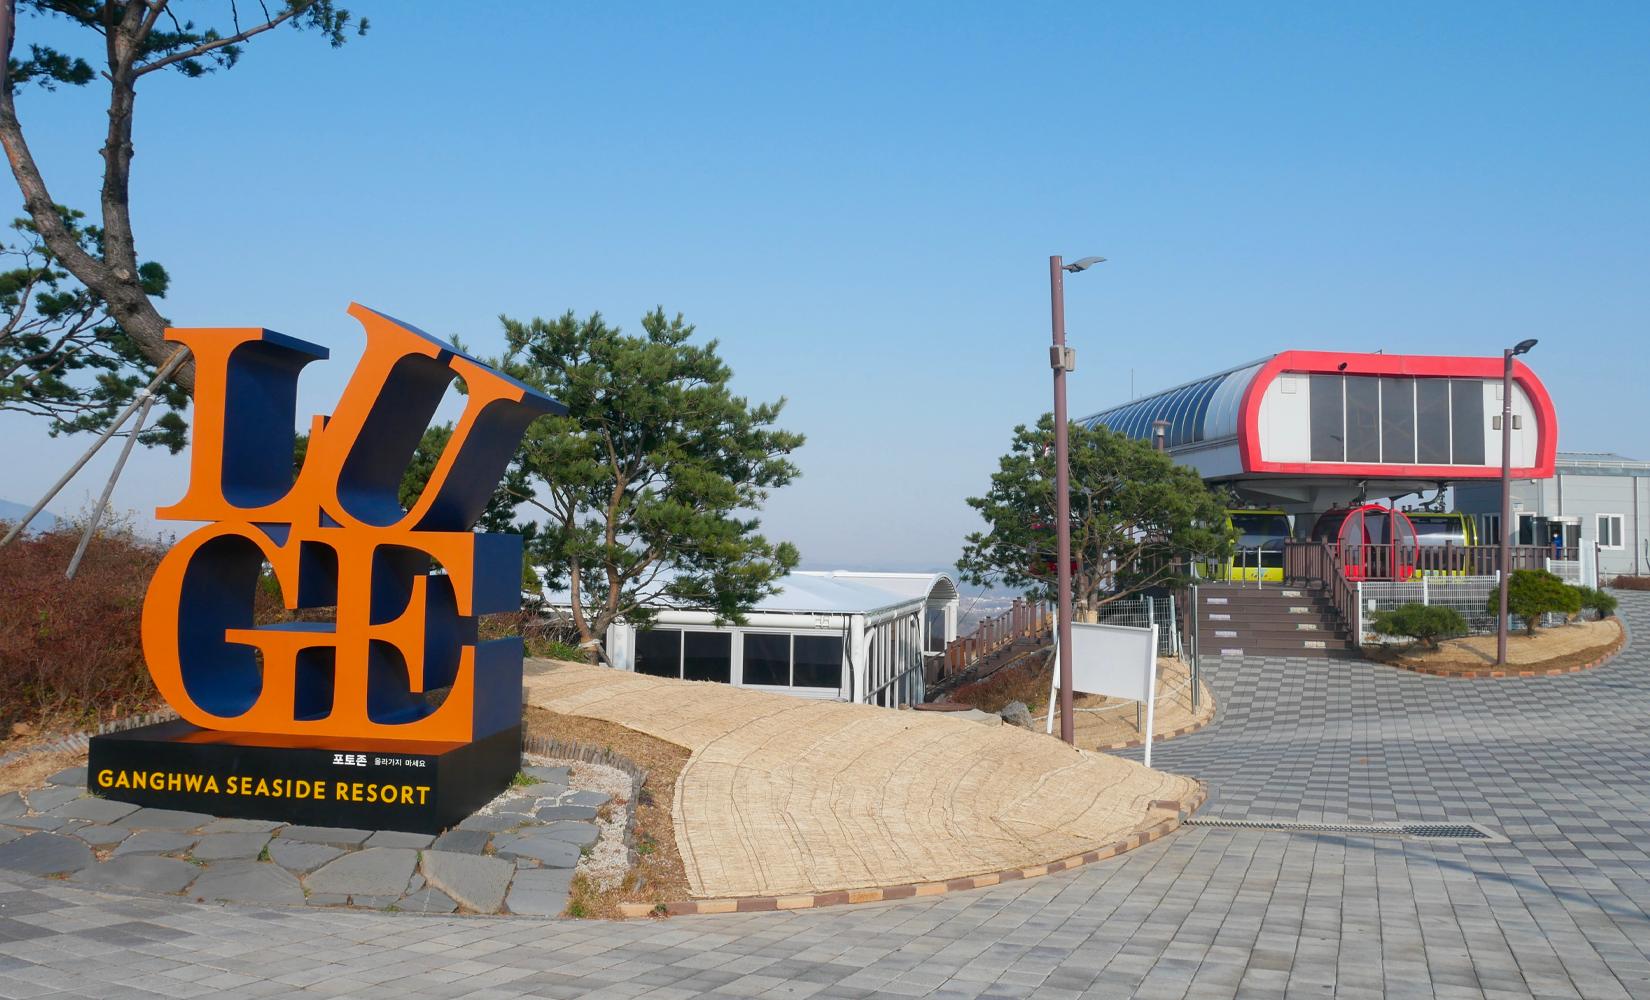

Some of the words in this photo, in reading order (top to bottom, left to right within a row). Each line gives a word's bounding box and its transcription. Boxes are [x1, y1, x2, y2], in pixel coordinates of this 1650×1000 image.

[332, 753, 368, 767] 포토존
[374, 757, 402, 767] 올라가지
[405, 759, 426, 768] 마세요
[97, 769, 220, 794] GANGHWA
[226, 776, 326, 800] SEASIDE
[336, 782, 431, 805] RESORT
